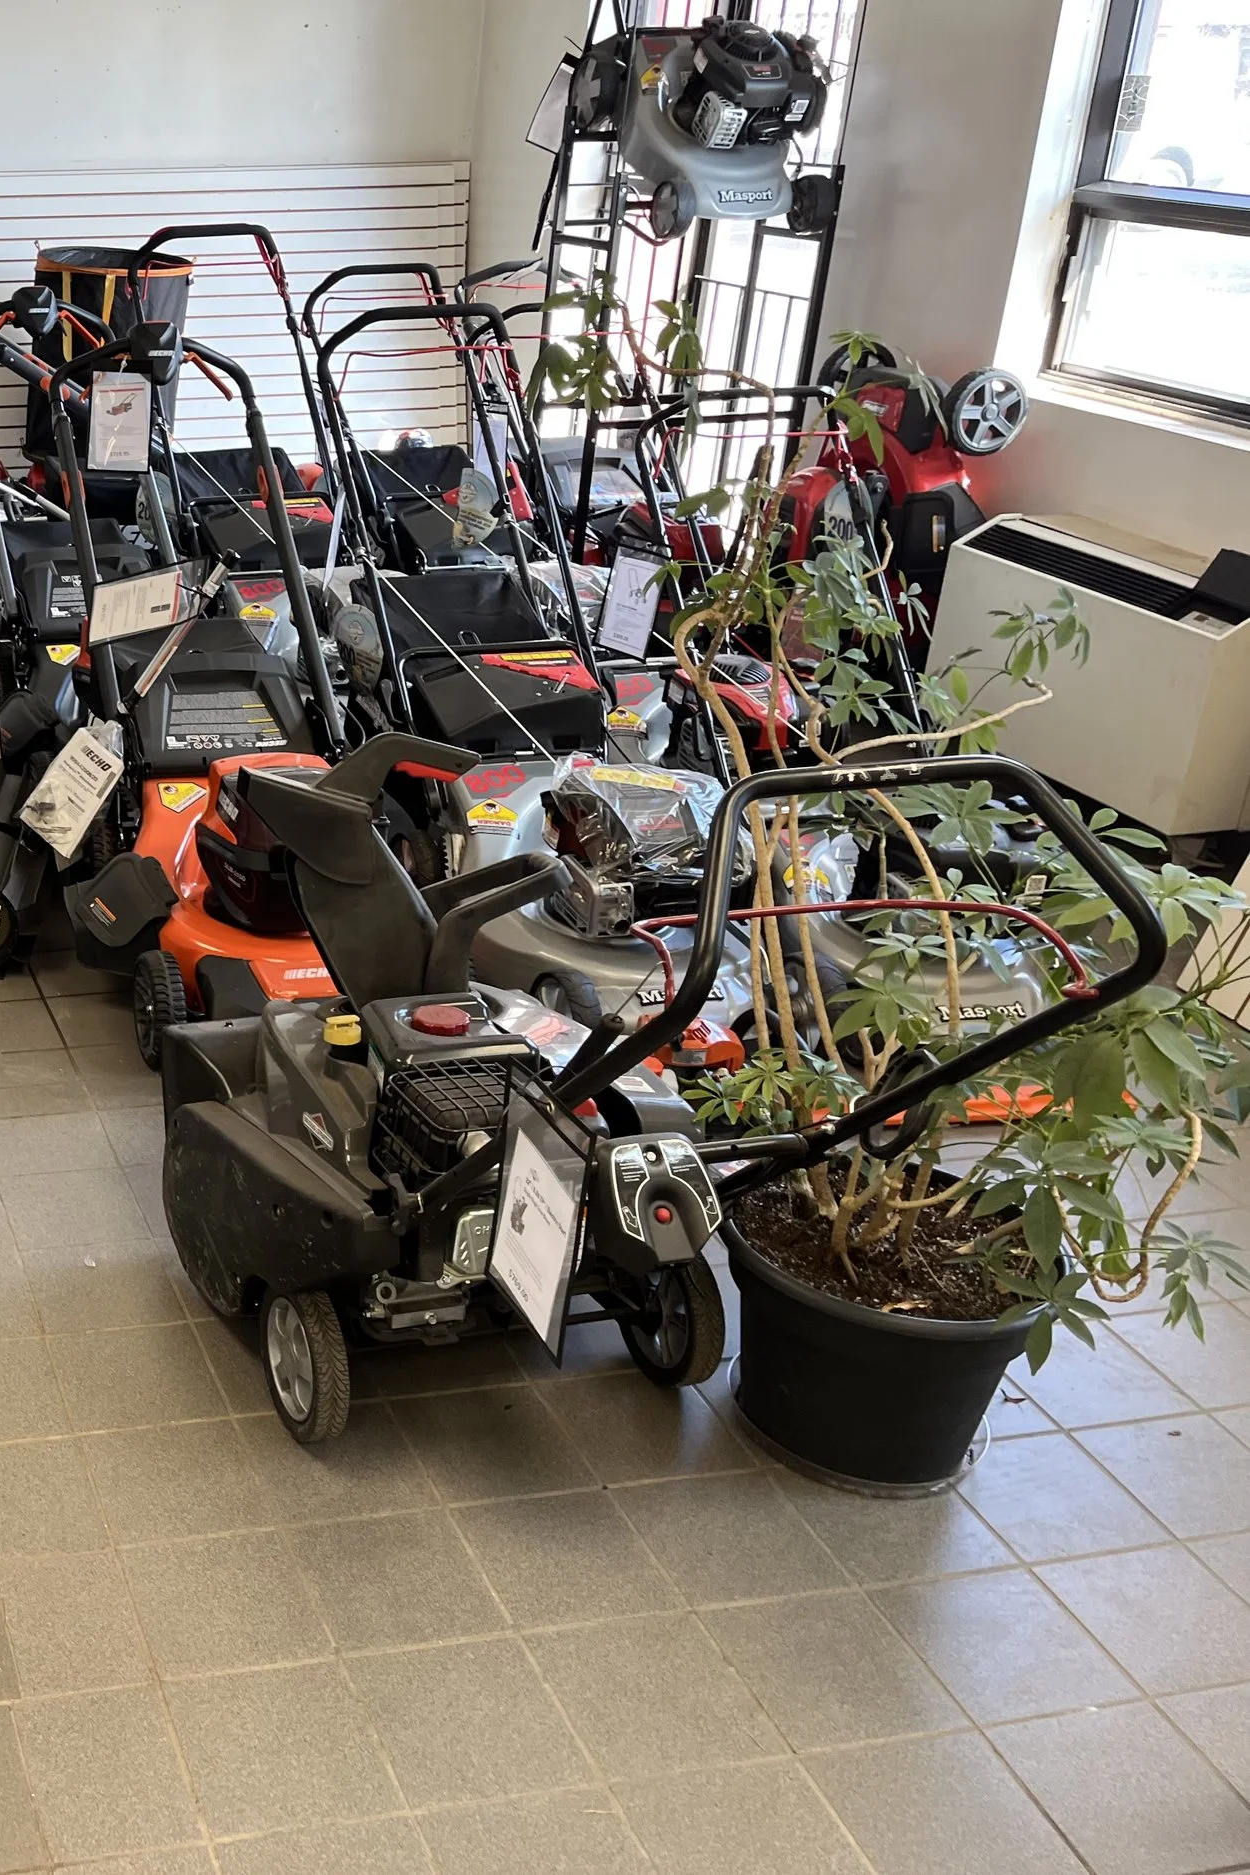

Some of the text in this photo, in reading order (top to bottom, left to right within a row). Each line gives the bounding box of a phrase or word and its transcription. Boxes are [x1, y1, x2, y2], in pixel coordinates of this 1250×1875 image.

[718, 188, 773, 204] Masport
[85, 748, 112, 772] ECHO
[464, 765, 526, 793] 800
[287, 967, 330, 980] ECH
[936, 1001, 1027, 1021] Masort
